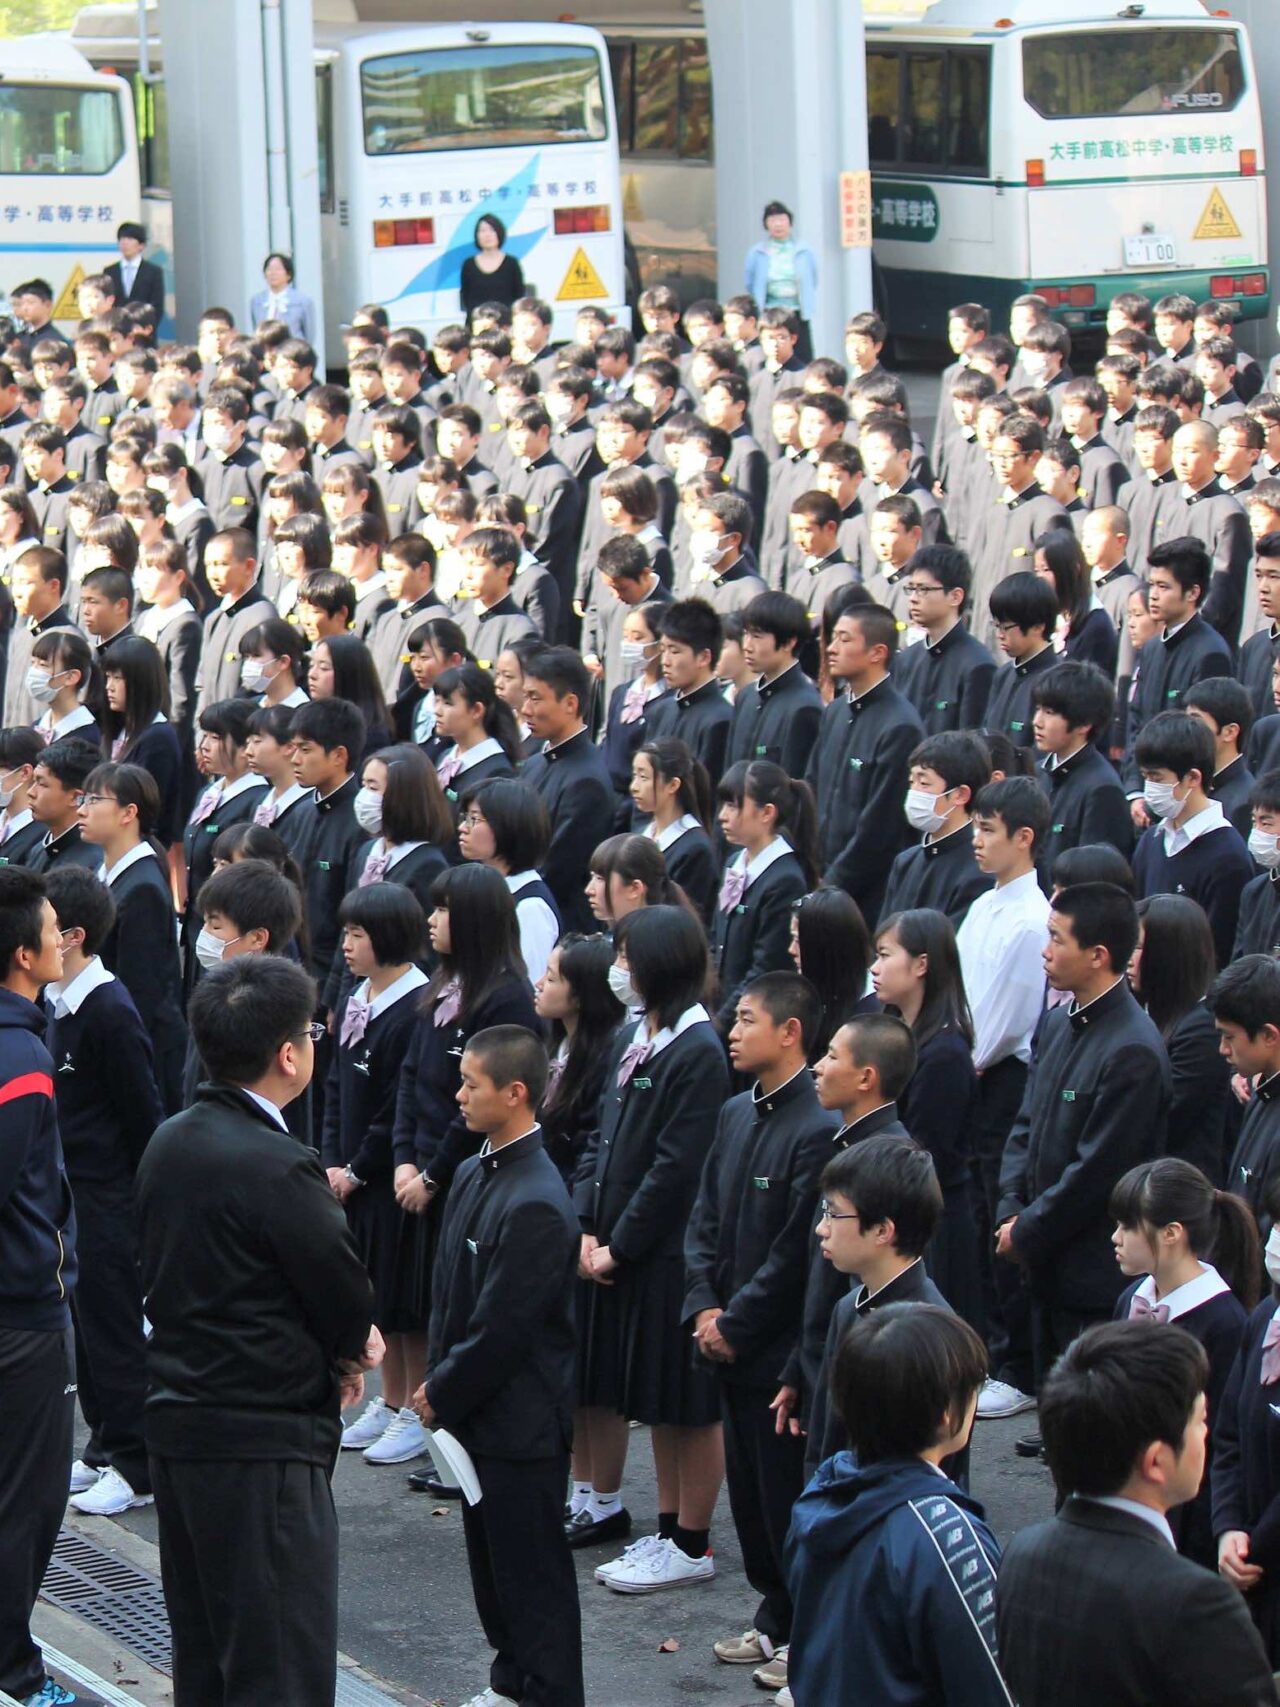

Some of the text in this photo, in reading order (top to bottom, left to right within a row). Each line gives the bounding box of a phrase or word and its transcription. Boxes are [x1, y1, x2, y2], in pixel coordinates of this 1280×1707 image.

[1174, 92, 1223, 108] FUSO
[1049, 135, 1234, 161] 大手前高松中学・高等学校
[379, 180, 598, 209] 大手前高松中学・高等学校
